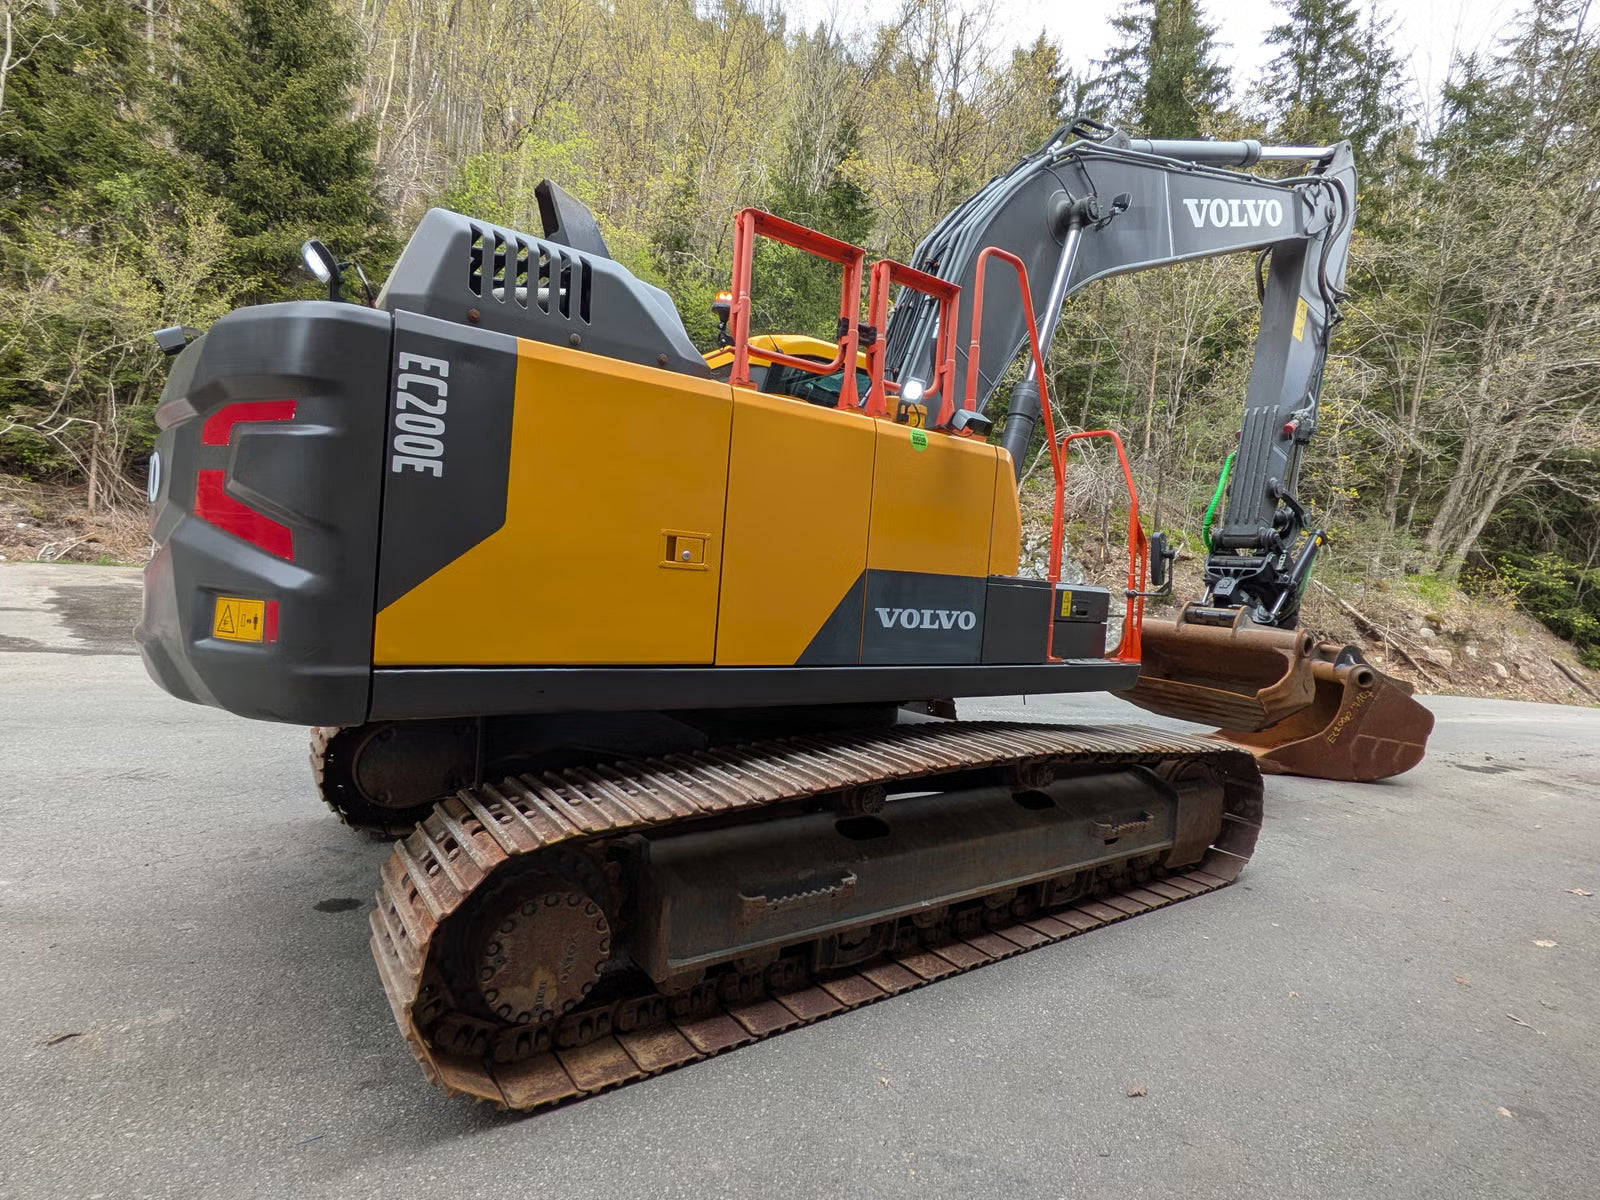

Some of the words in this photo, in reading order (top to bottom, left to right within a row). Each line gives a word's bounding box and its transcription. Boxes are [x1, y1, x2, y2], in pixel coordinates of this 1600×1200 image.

[1183, 198, 1283, 228] VOLVO
[392, 351, 450, 478] EC200E
[875, 607, 977, 631] VOLVO
